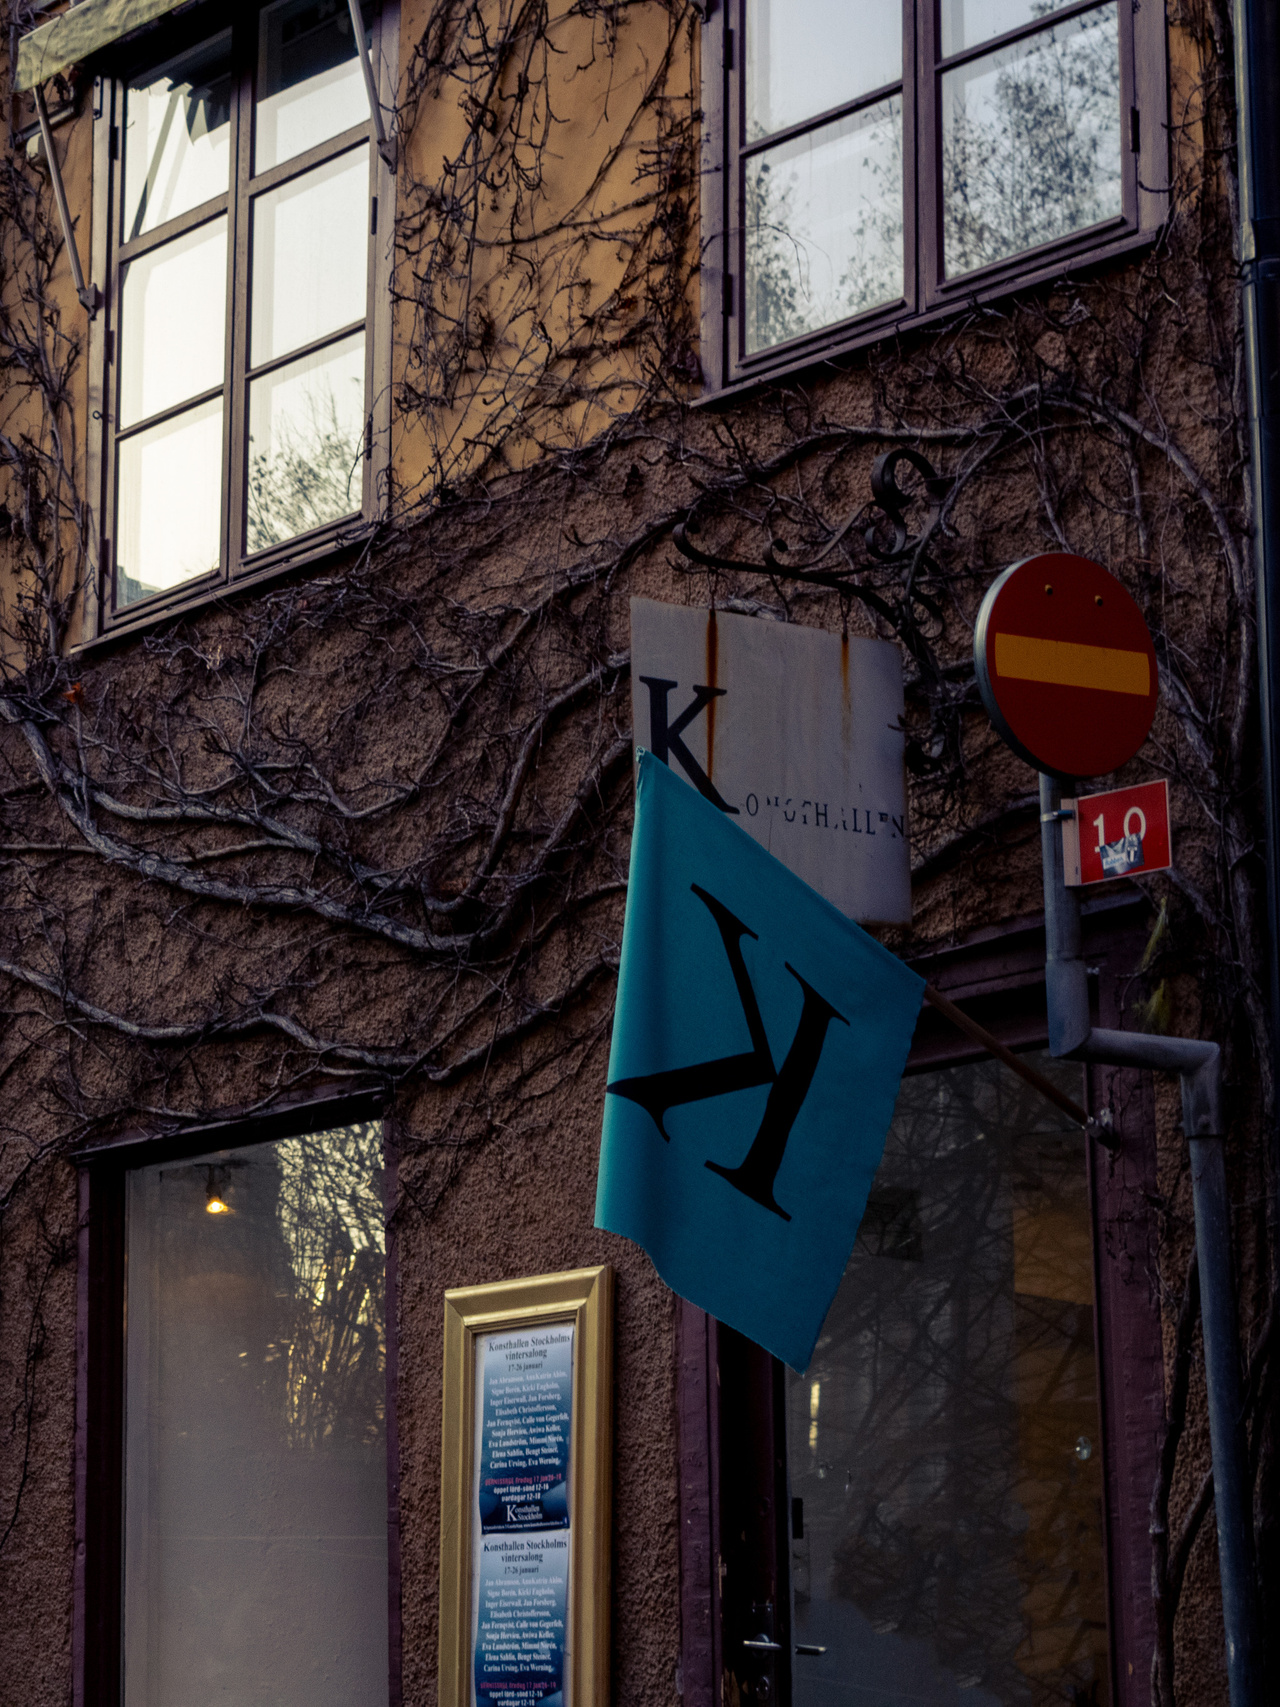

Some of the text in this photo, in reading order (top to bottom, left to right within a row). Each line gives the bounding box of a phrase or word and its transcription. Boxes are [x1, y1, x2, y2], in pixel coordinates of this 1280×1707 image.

[1093, 806, 1147, 854] 10
[489, 1334, 570, 1352] Konsthallen Stockholms
[506, 1349, 547, 1360] vintersalong
[523, 1361, 543, 1372] januari
[484, 1539, 567, 1552] Konsthallen Stockholms
[502, 1552, 543, 1563] vintersalong
[519, 1565, 539, 1575] januari
